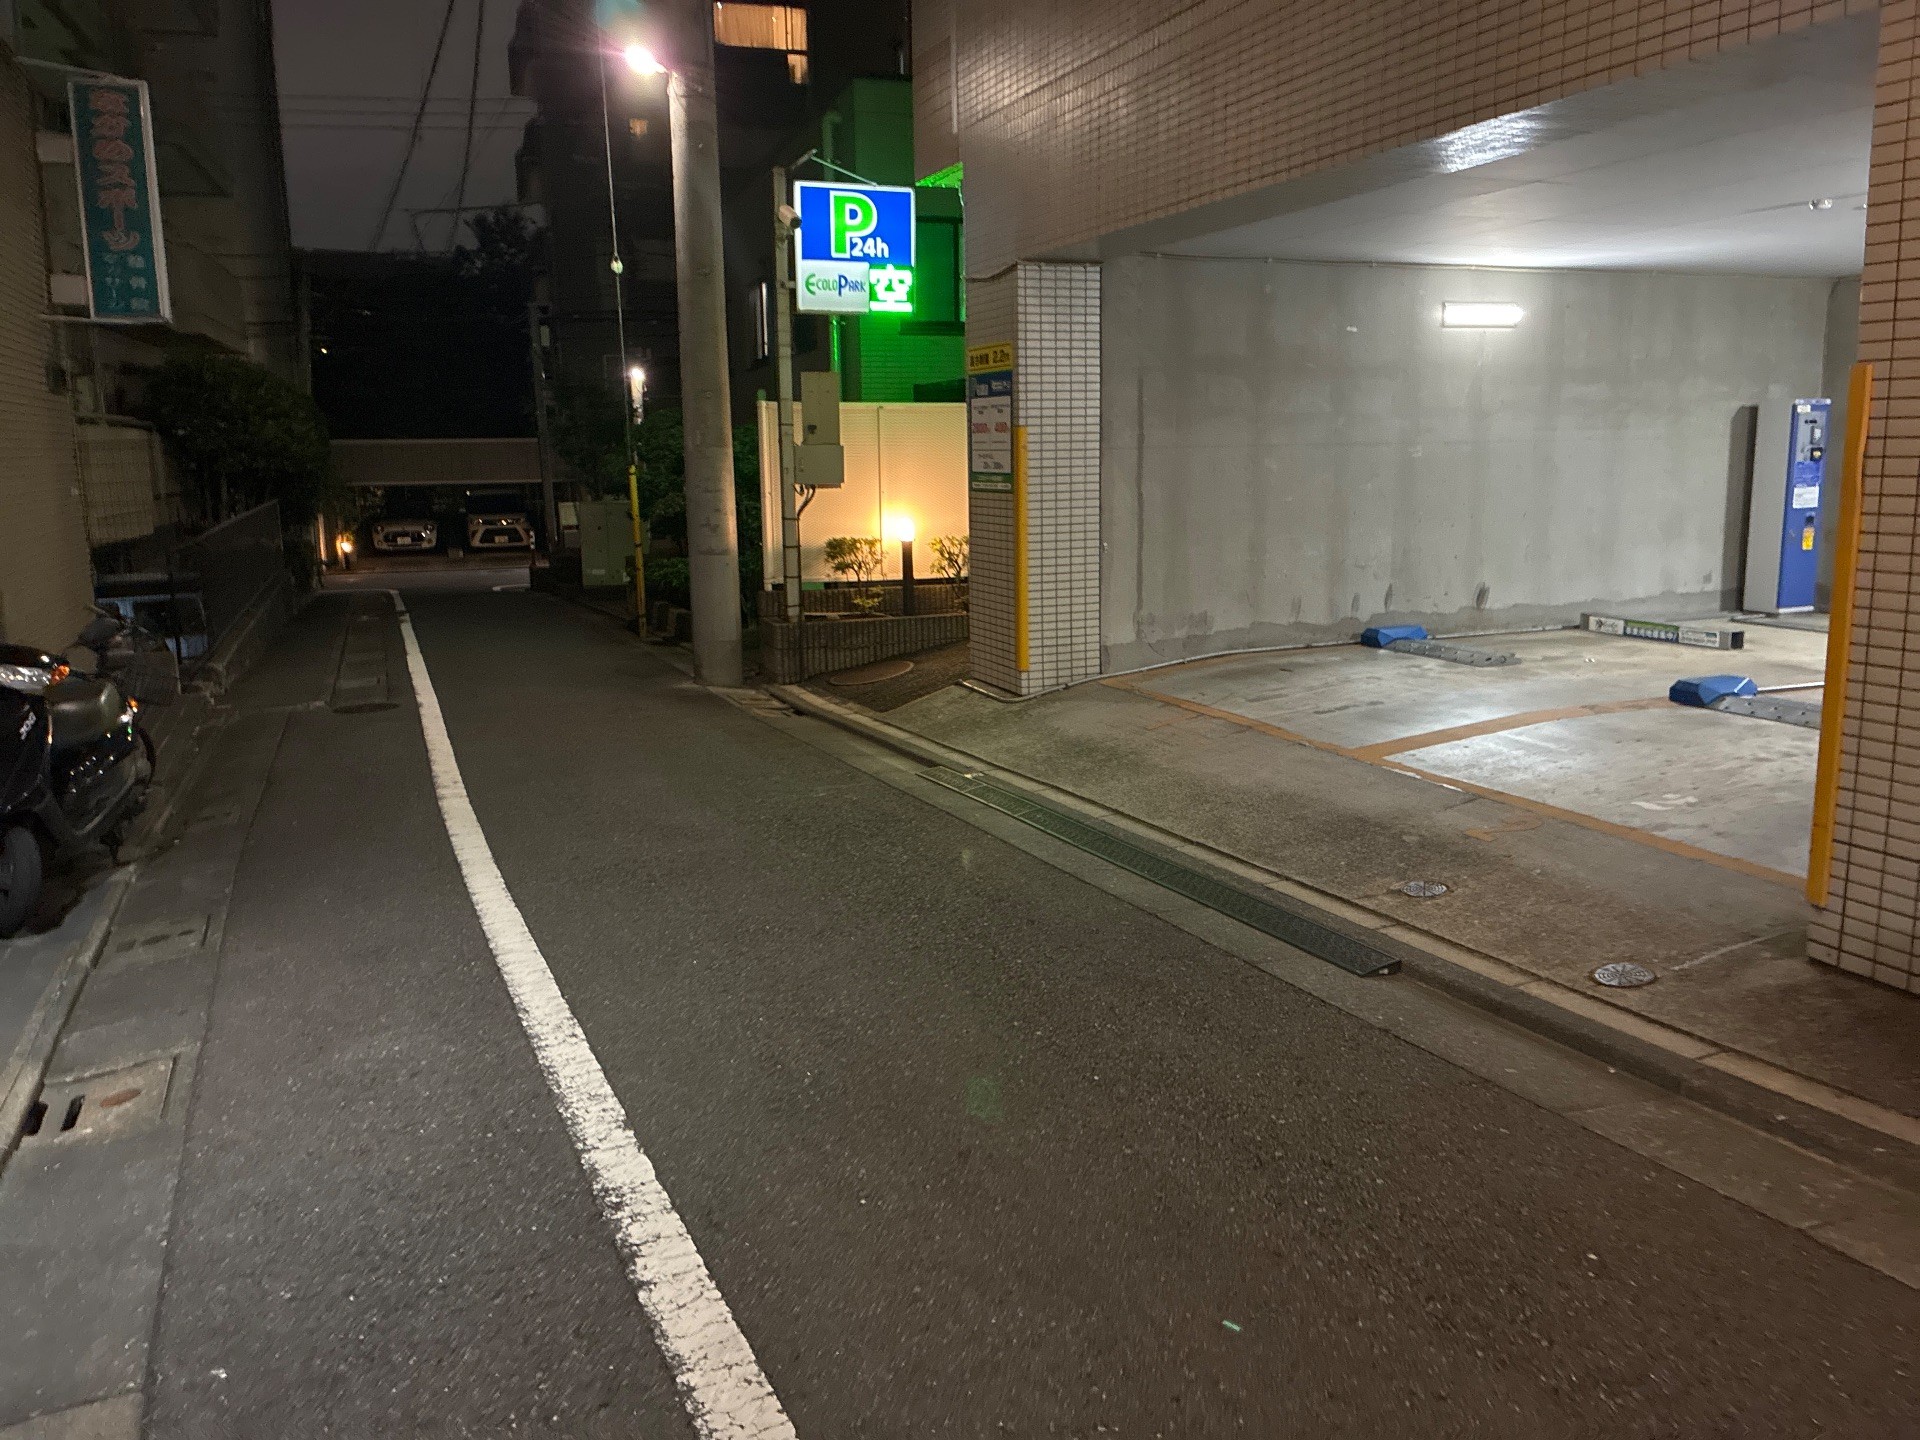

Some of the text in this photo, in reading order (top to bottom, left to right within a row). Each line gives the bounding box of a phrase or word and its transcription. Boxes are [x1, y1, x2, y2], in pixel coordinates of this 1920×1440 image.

[830, 190, 878, 259] P
[851, 236, 889, 258] 24h
[869, 264, 912, 312] 空
